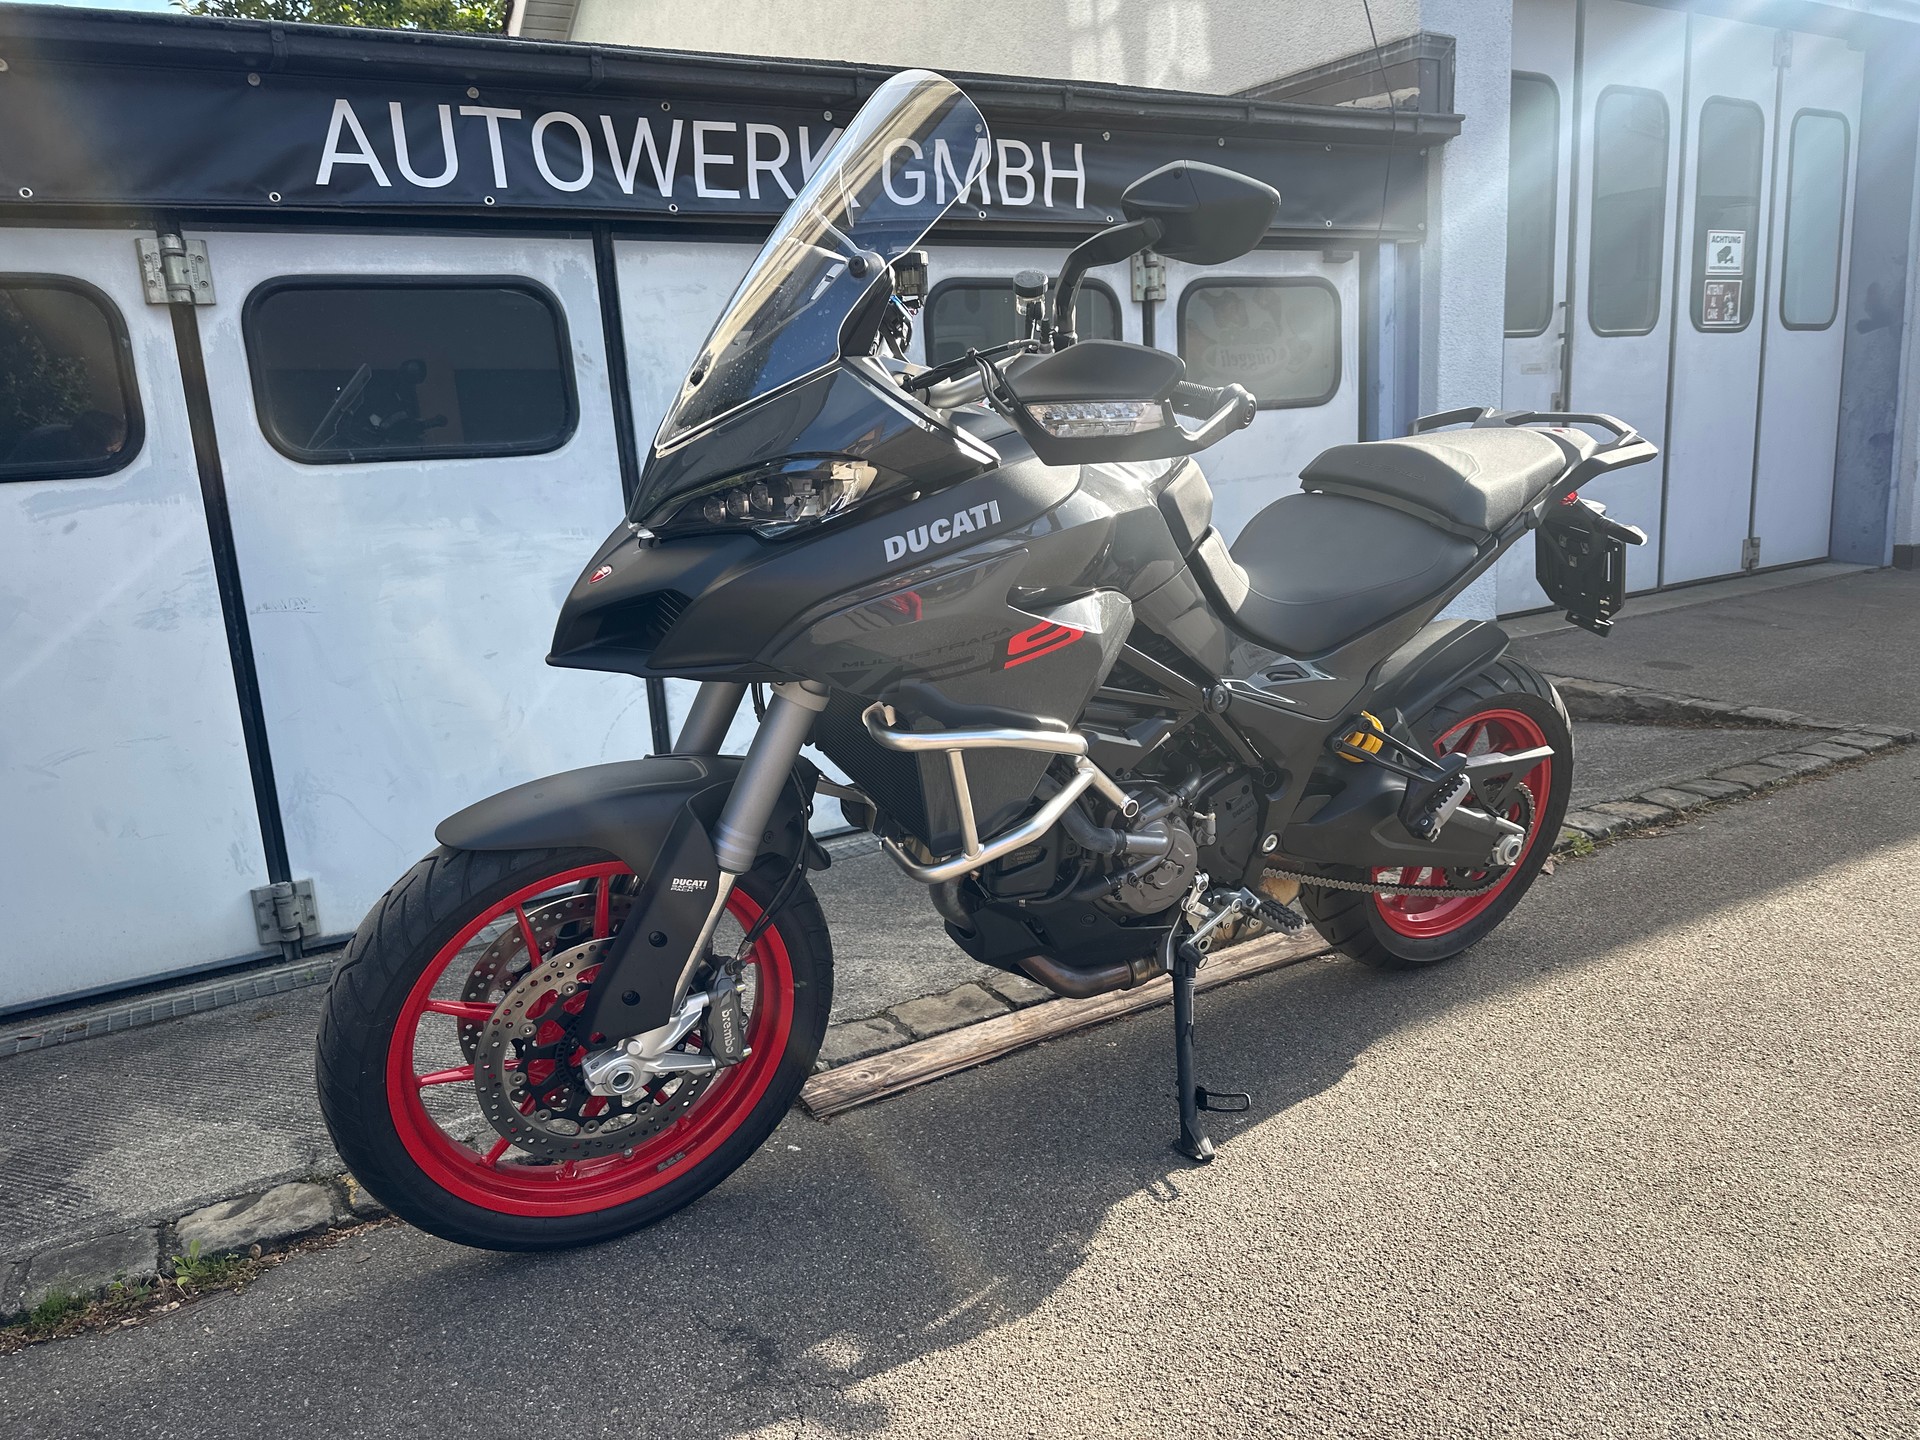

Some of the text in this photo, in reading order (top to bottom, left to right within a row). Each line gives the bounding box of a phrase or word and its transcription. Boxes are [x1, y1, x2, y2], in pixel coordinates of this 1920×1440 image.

[881, 137, 1086, 209] GMBH
[1711, 235, 1741, 244] ACHTUNG
[883, 499, 1002, 563] DUCATI
[672, 878, 708, 887] DUCATI
[721, 1008, 734, 1054] brembo
